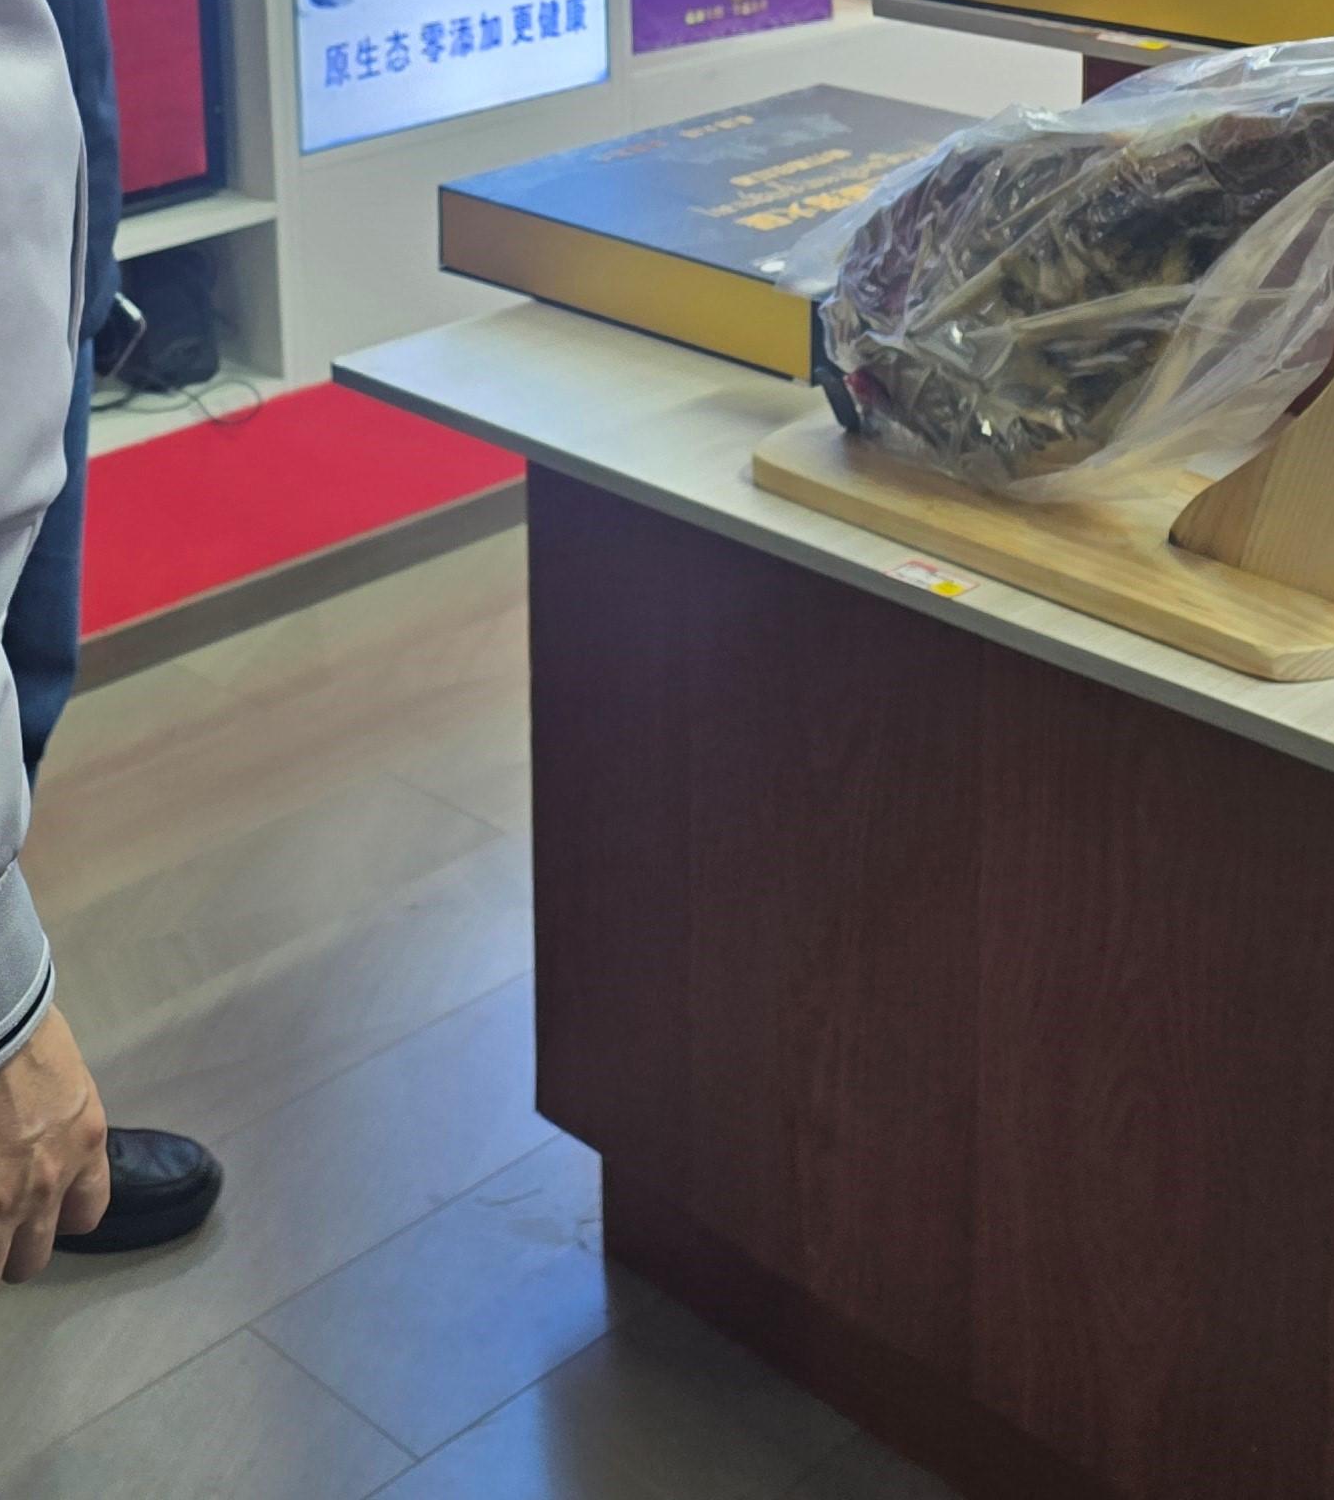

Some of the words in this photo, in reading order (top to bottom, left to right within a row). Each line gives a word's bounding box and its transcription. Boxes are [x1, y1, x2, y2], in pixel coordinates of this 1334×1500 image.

[324, 29, 411, 88] 原生态
[419, 12, 503, 63] 零添加
